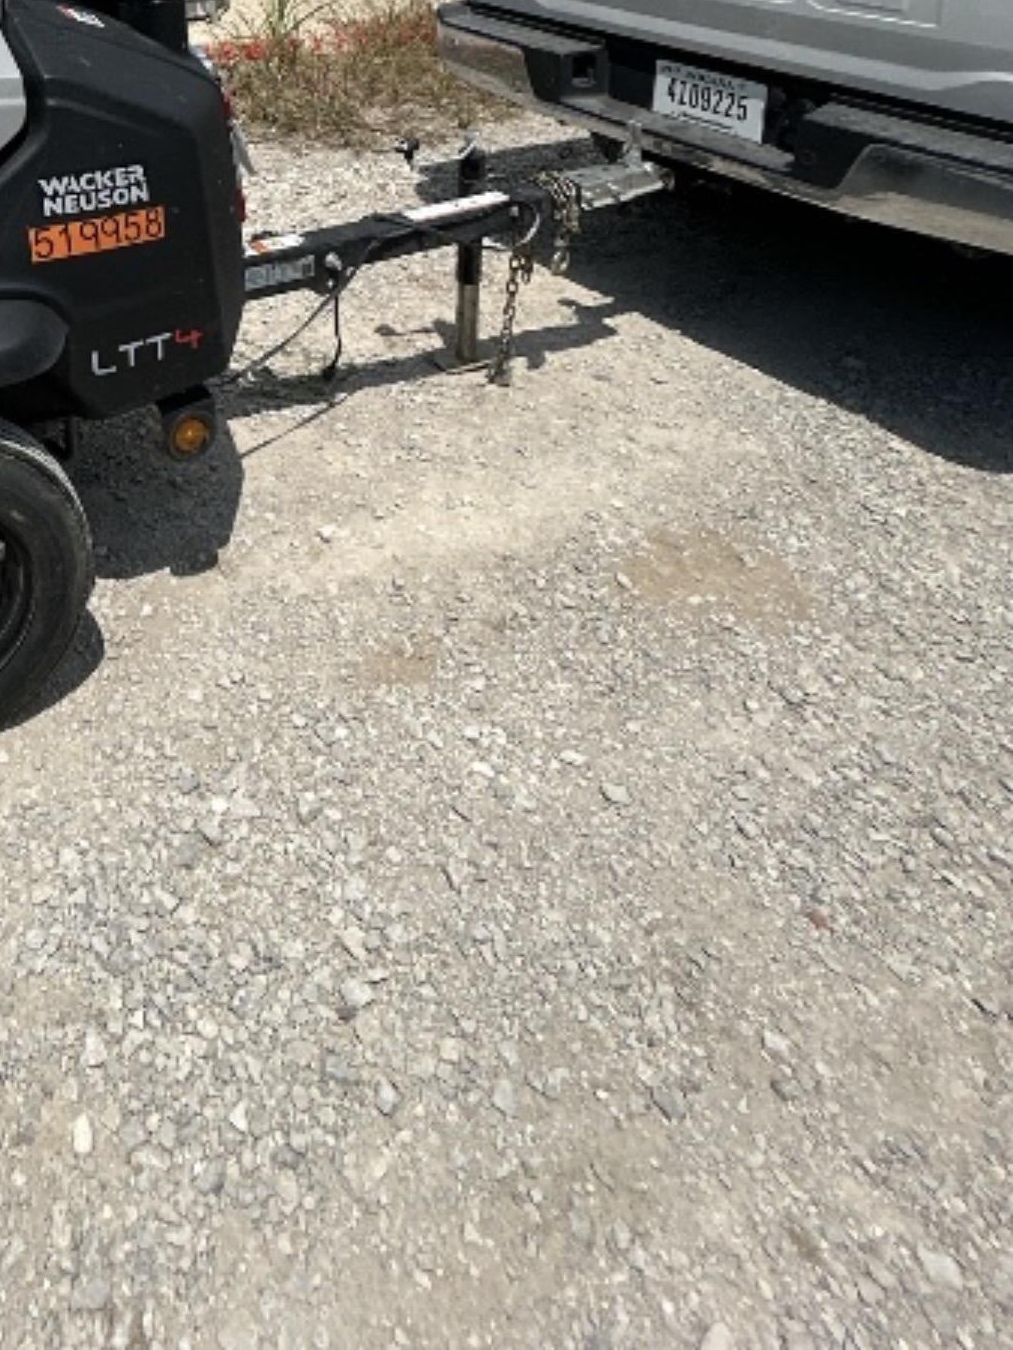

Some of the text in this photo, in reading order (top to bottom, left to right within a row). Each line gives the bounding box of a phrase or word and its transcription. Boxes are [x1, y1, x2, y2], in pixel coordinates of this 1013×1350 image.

[38, 164, 145, 196] WACKER
[43, 182, 150, 217] NEUSON
[34, 209, 163, 259] 519958
